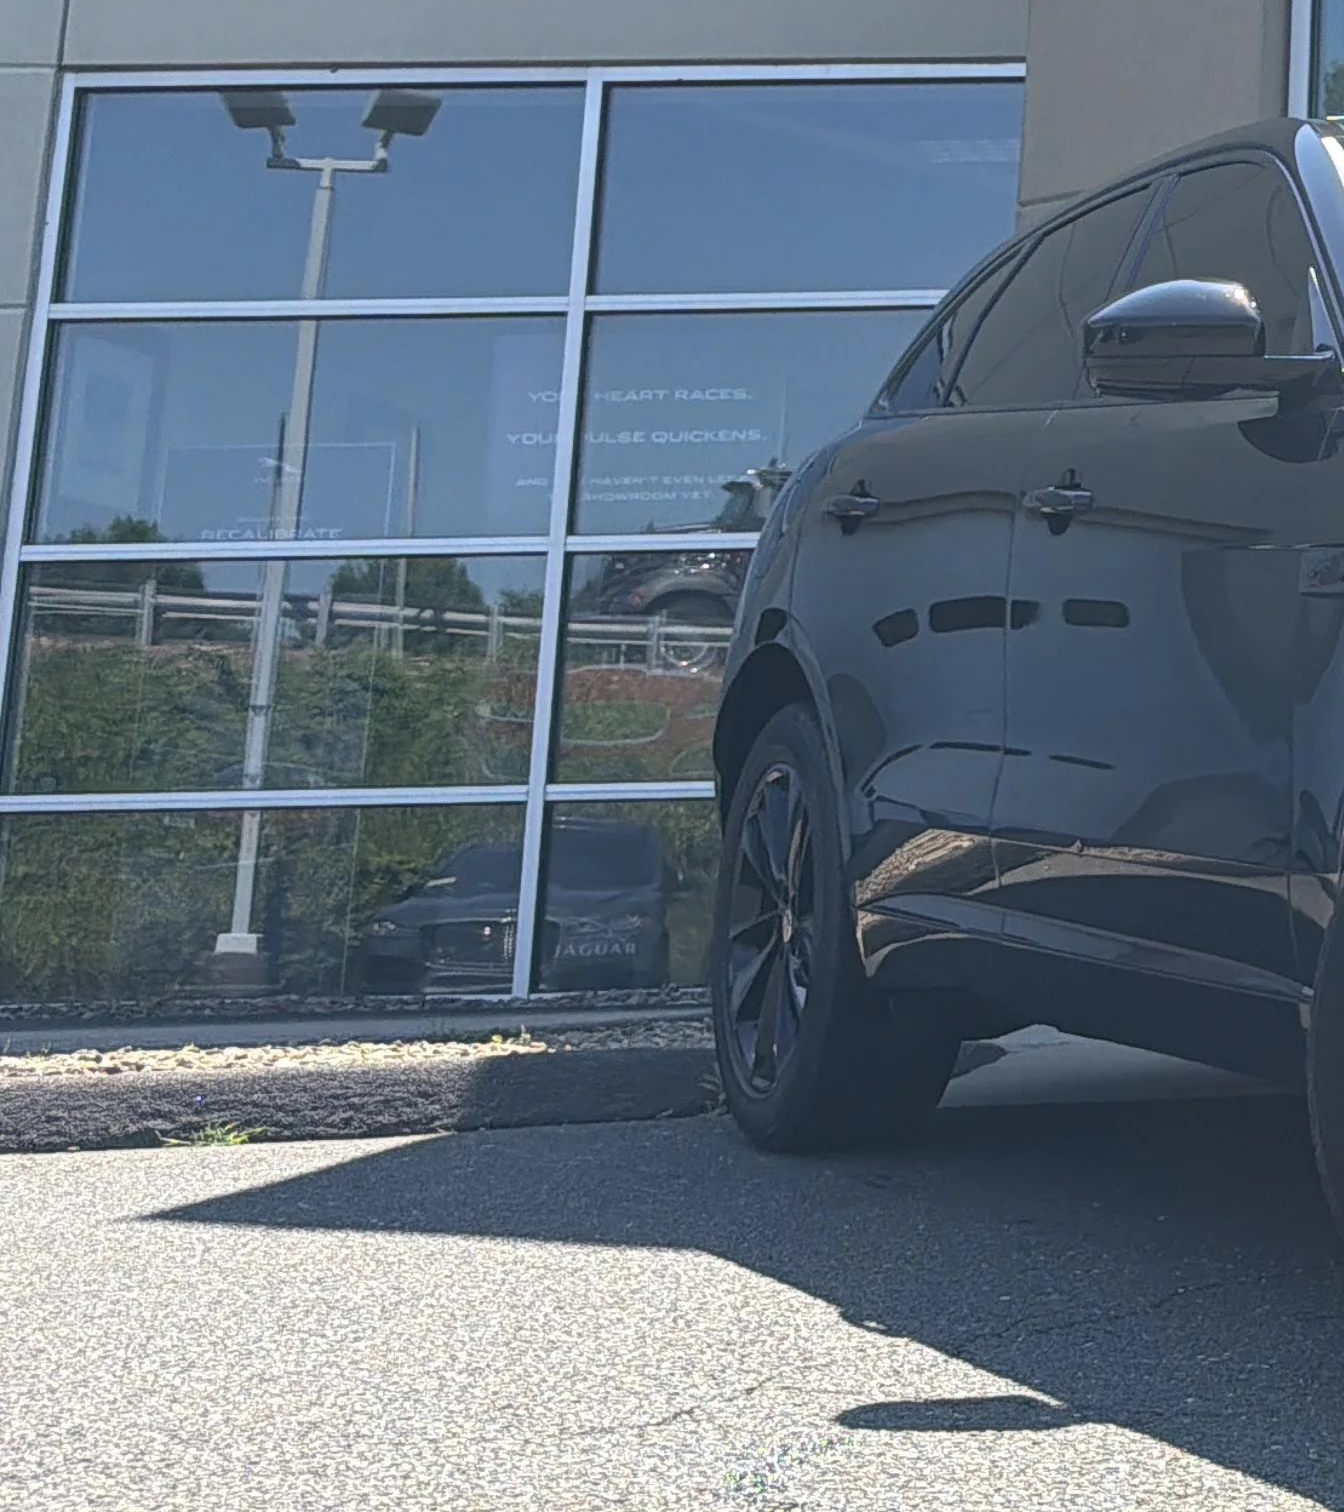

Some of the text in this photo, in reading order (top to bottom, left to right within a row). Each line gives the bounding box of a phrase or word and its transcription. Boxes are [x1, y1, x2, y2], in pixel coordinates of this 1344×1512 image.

[526, 387, 755, 403] YO HEART RACES.
[506, 428, 768, 445] YOU ULSE QUICKENS.
[554, 942, 637, 959] JAGUAR
